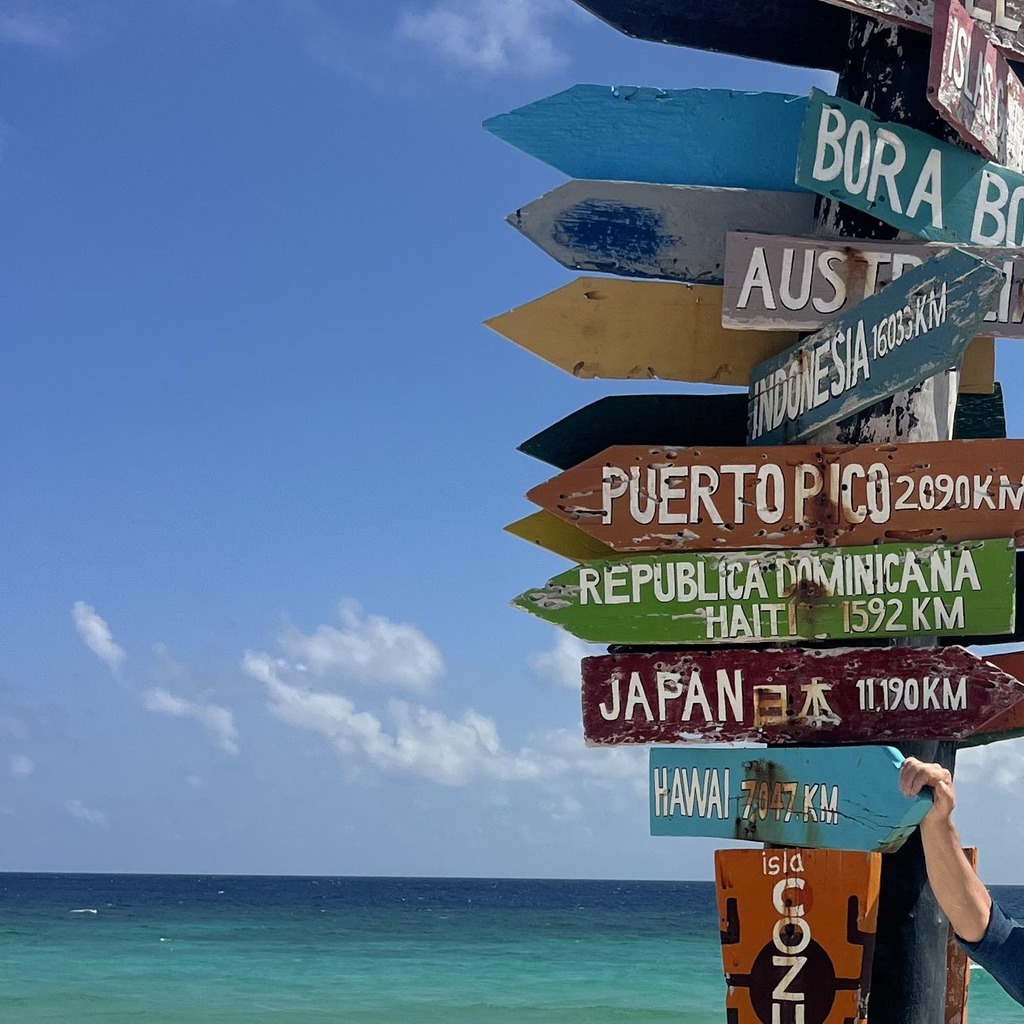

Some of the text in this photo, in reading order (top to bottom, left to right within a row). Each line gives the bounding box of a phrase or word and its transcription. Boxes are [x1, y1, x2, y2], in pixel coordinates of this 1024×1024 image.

[812, 103, 943, 229] BORA
[751, 319, 870, 440] INDONESIA
[602, 463, 785, 525] PUERTO
[579, 550, 982, 605] REPUBLICA DOMINICANA
[706, 602, 798, 638] HAITI
[599, 669, 744, 722] JAPAN
[654, 767, 730, 819] HAWAI
[762, 852, 805, 875] isla
